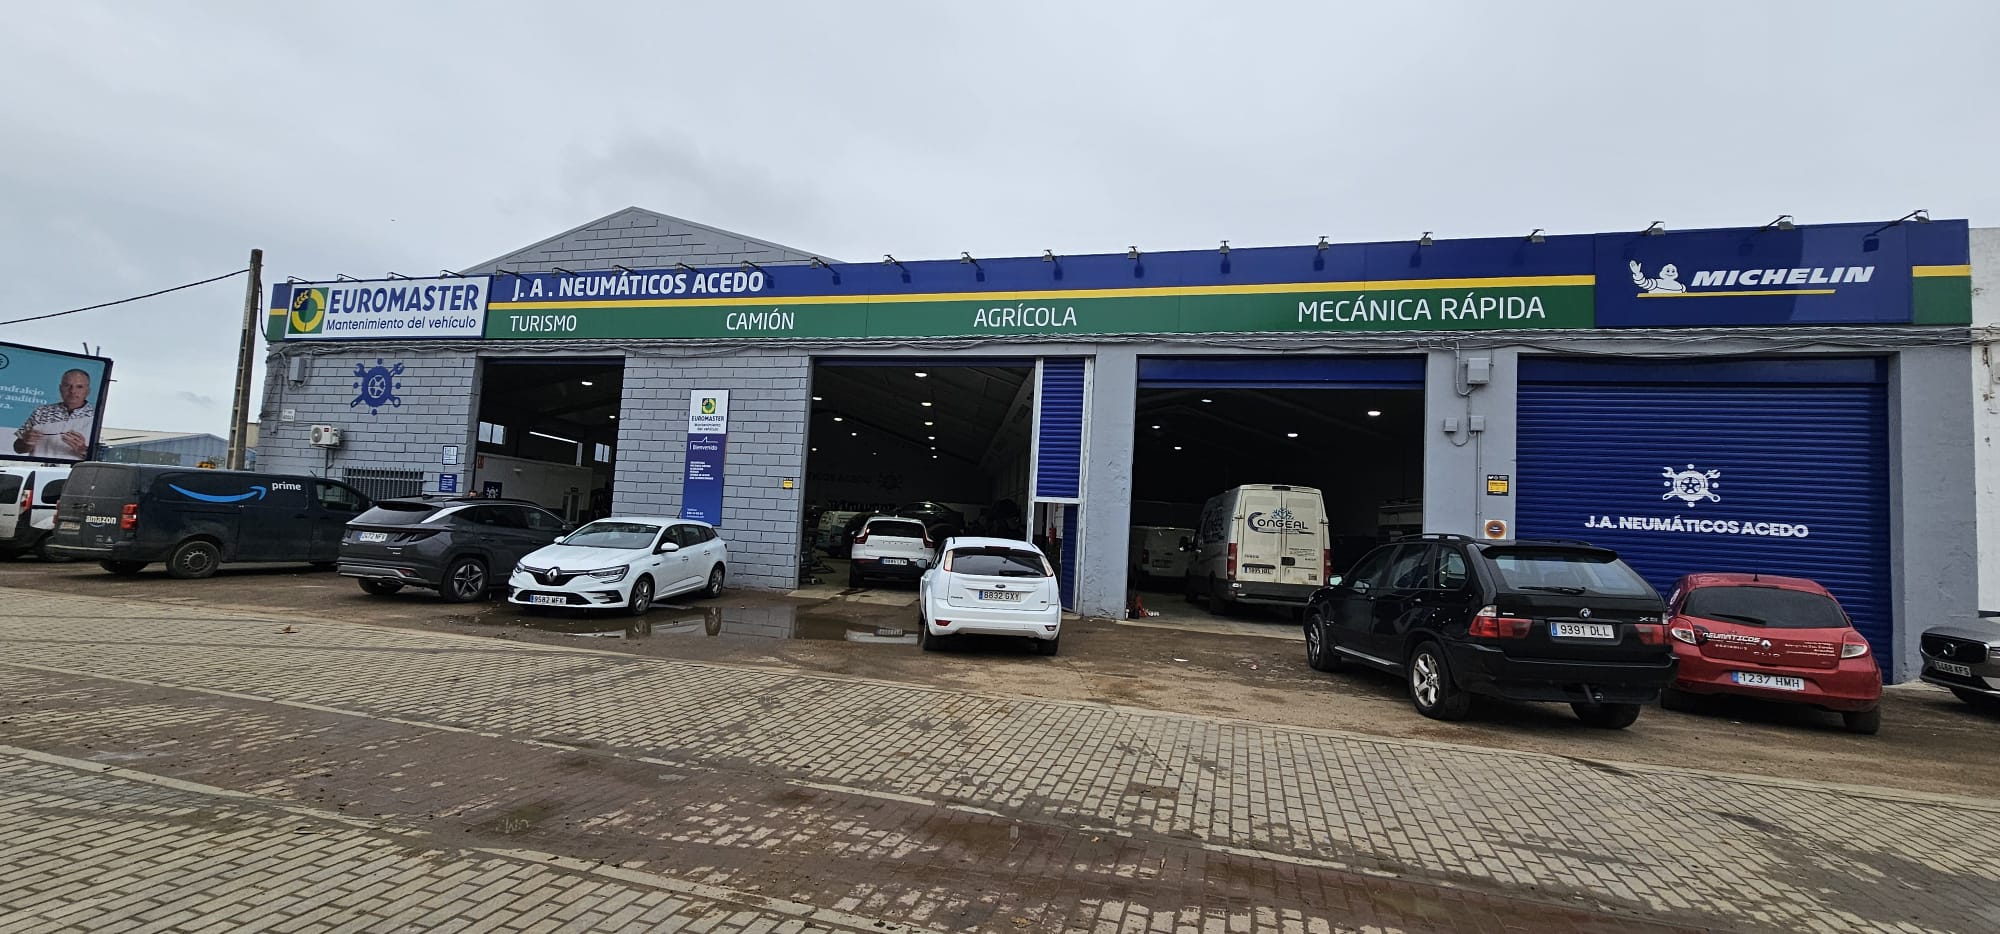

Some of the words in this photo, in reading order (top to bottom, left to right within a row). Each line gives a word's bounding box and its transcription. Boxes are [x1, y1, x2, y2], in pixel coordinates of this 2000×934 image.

[1690, 265, 1875, 287] MICHELIN
[511, 278, 525, 302] J.
[559, 271, 687, 297] NEUMÁTICOS
[691, 271, 764, 294] ACEDO
[328, 284, 479, 314] EUROMASTER
[1298, 295, 1432, 322] MECÁNICA
[1441, 292, 1546, 320] RÁPIDA
[326, 318, 404, 331] Mantenimiento
[408, 316, 425, 329] del
[429, 315, 476, 329] vehículo
[510, 314, 577, 332] TURISMO
[726, 308, 795, 330] CAMIÓN
[974, 303, 1077, 327] AGRÍCOLA
[4, 393, 48, 404] auditivo
[271, 481, 302, 492] prime
[85, 515, 117, 524] amazon
[1584, 515, 1617, 529] J.A.
[1619, 514, 1740, 534] NEUMÁTICOS
[1741, 521, 1809, 538] ACEDO
[534, 595, 550, 604] 9582
[983, 591, 1003, 600] 8832
[1005, 591, 1020, 601] GXY
[1560, 624, 1586, 636] 9391
[1590, 625, 1611, 637] DLL
[1742, 673, 1771, 684] 1237
[1775, 677, 1800, 688] HMH
